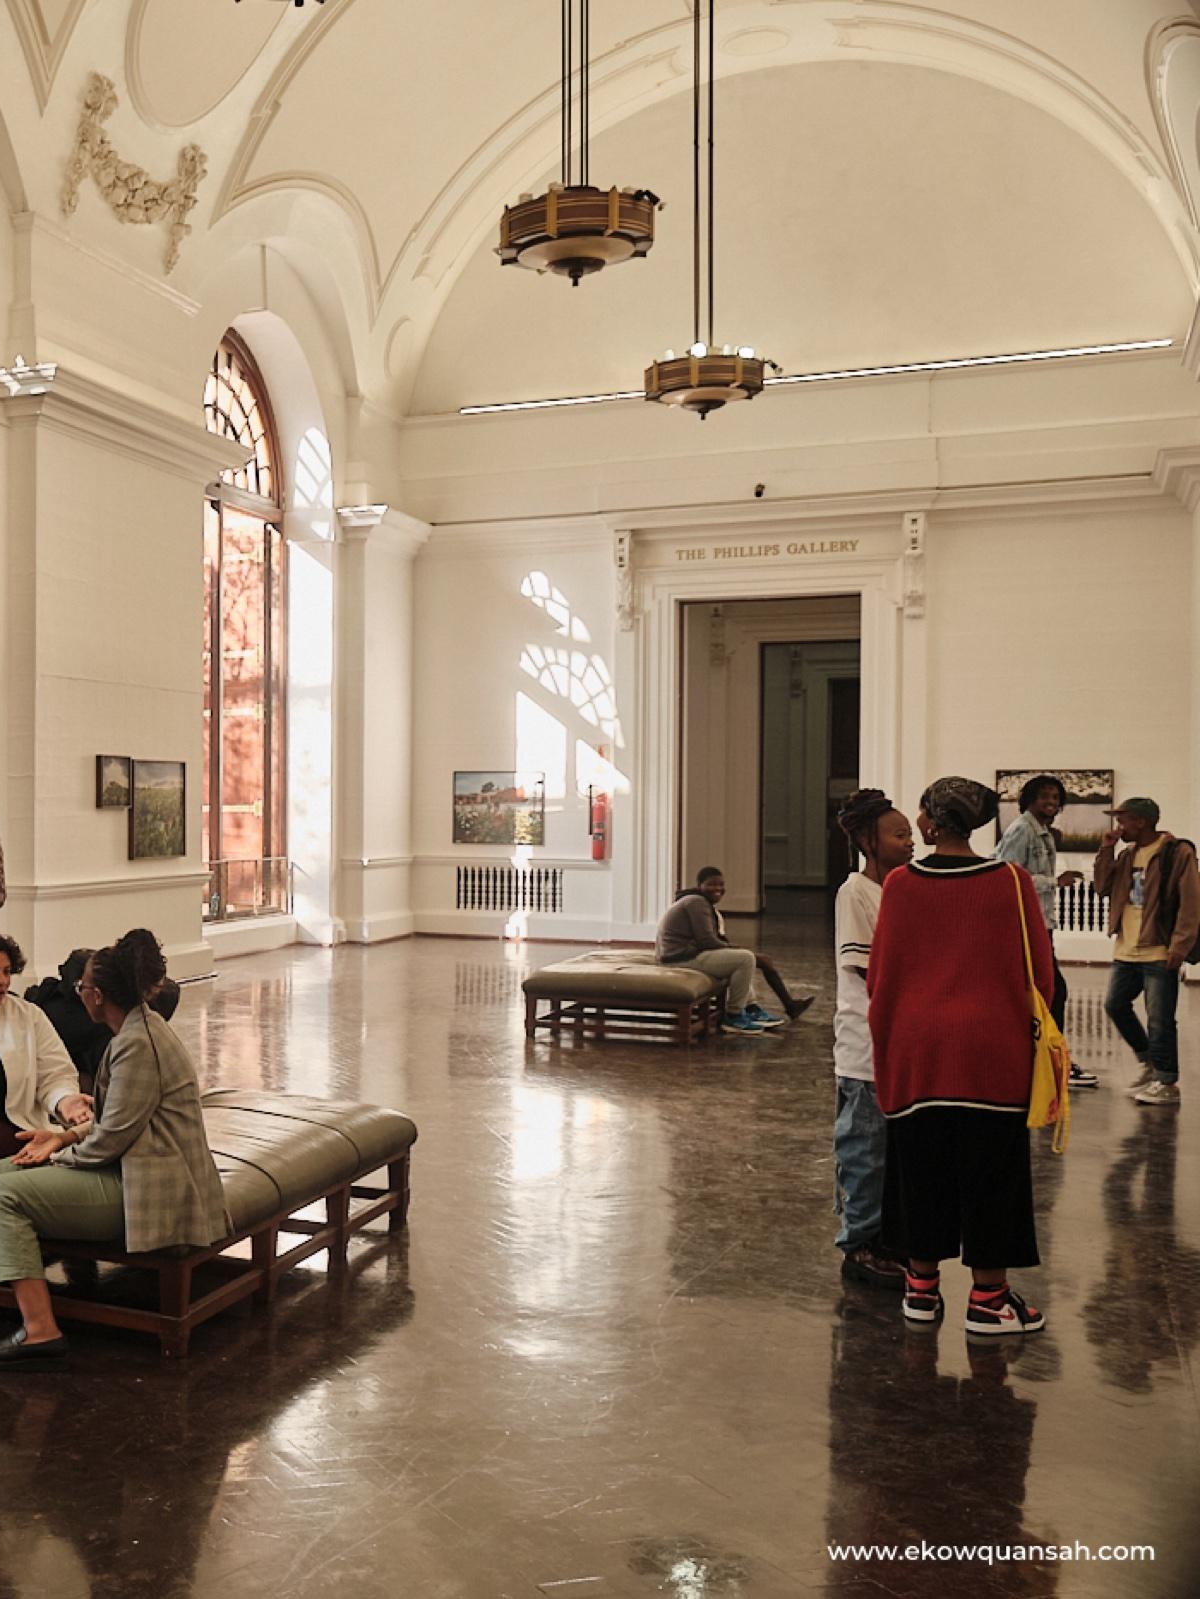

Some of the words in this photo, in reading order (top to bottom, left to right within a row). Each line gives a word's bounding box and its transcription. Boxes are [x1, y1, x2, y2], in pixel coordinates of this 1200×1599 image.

[676, 548, 706, 561] THE
[713, 544, 781, 560] PHILLIPS
[786, 539, 860, 555] GALLERY
